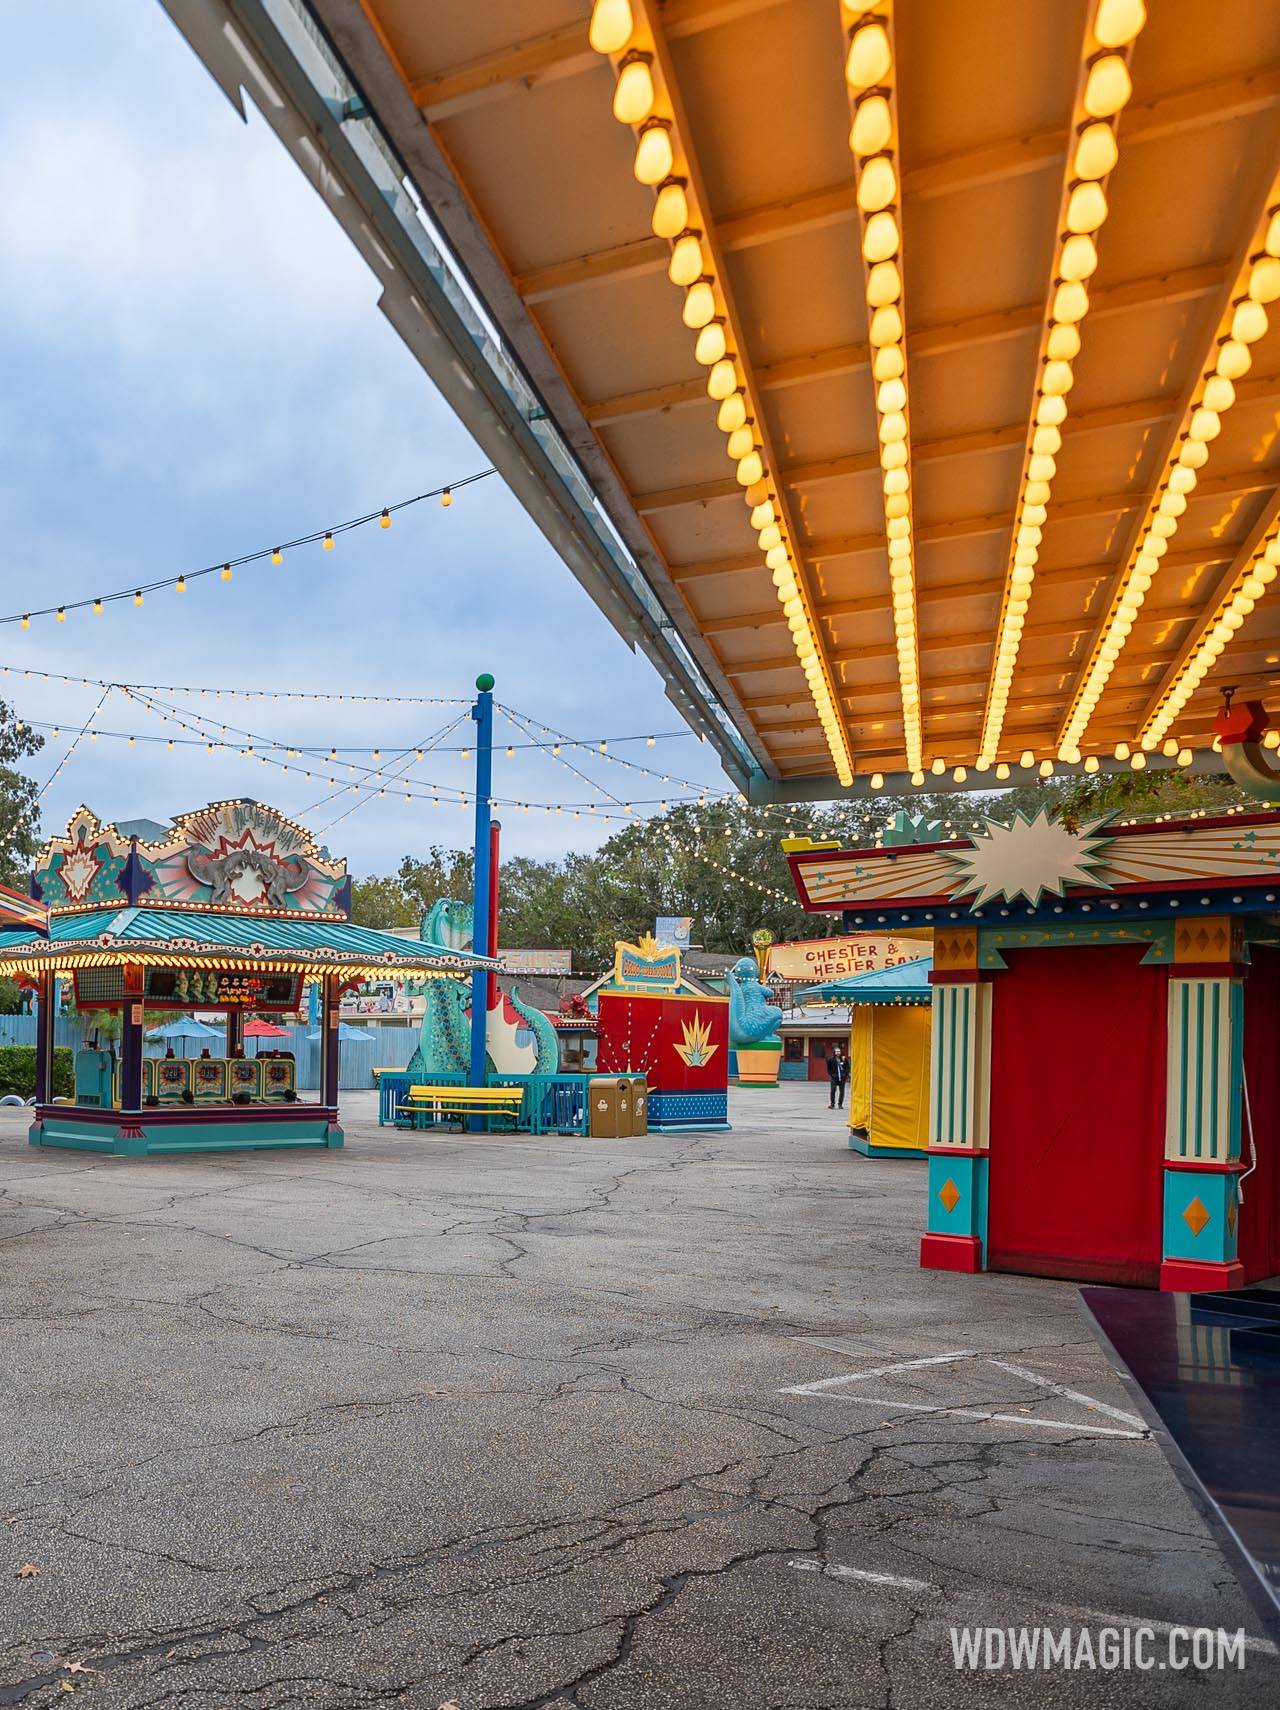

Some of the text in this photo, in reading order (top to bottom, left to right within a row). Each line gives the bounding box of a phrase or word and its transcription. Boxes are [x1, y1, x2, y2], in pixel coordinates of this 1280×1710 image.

[805, 943, 899, 962] CHESTER &
[814, 958, 875, 976] HESTER
